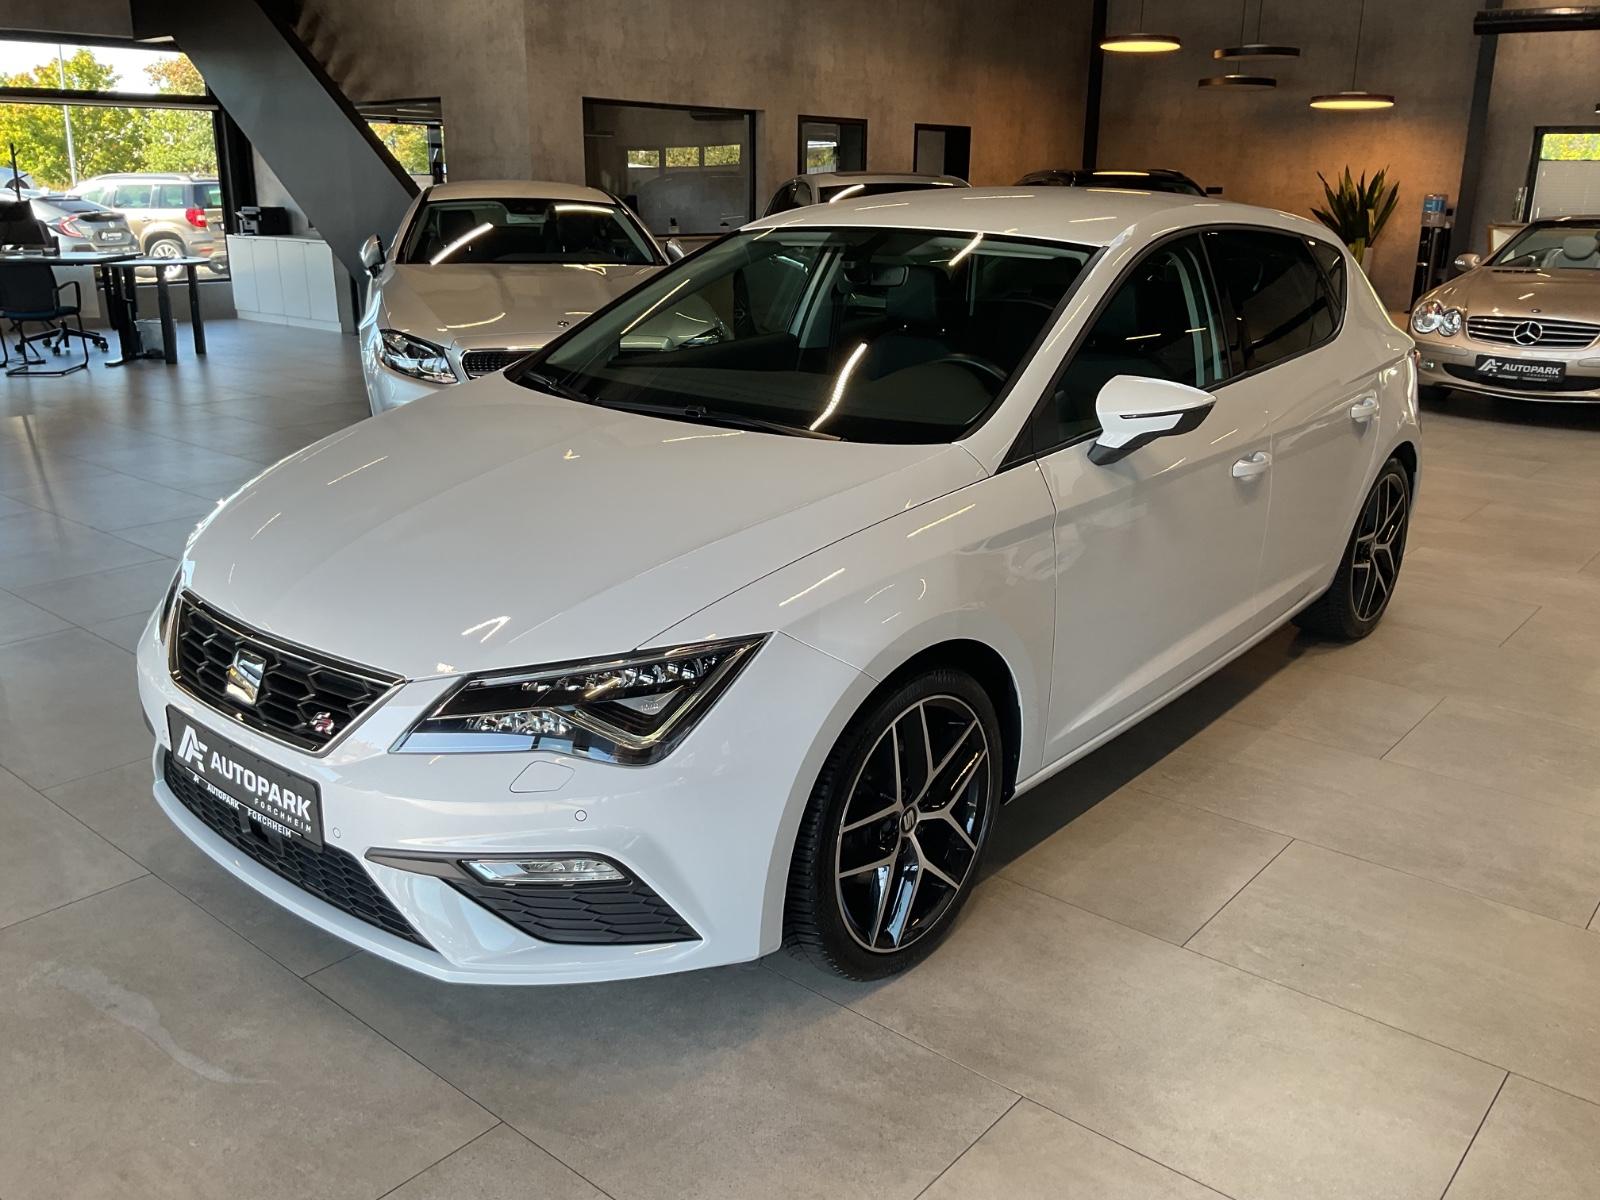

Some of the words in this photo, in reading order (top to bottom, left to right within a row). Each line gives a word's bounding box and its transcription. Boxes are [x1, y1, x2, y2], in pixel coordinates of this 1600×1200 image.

[1503, 363, 1561, 375] AUTOPARK
[211, 751, 312, 822] AUTOPARK
[207, 783, 240, 810] AUTOPARK
[247, 807, 292, 838] FORCHHEIM
[254, 798, 312, 833] FORCHHEIM
